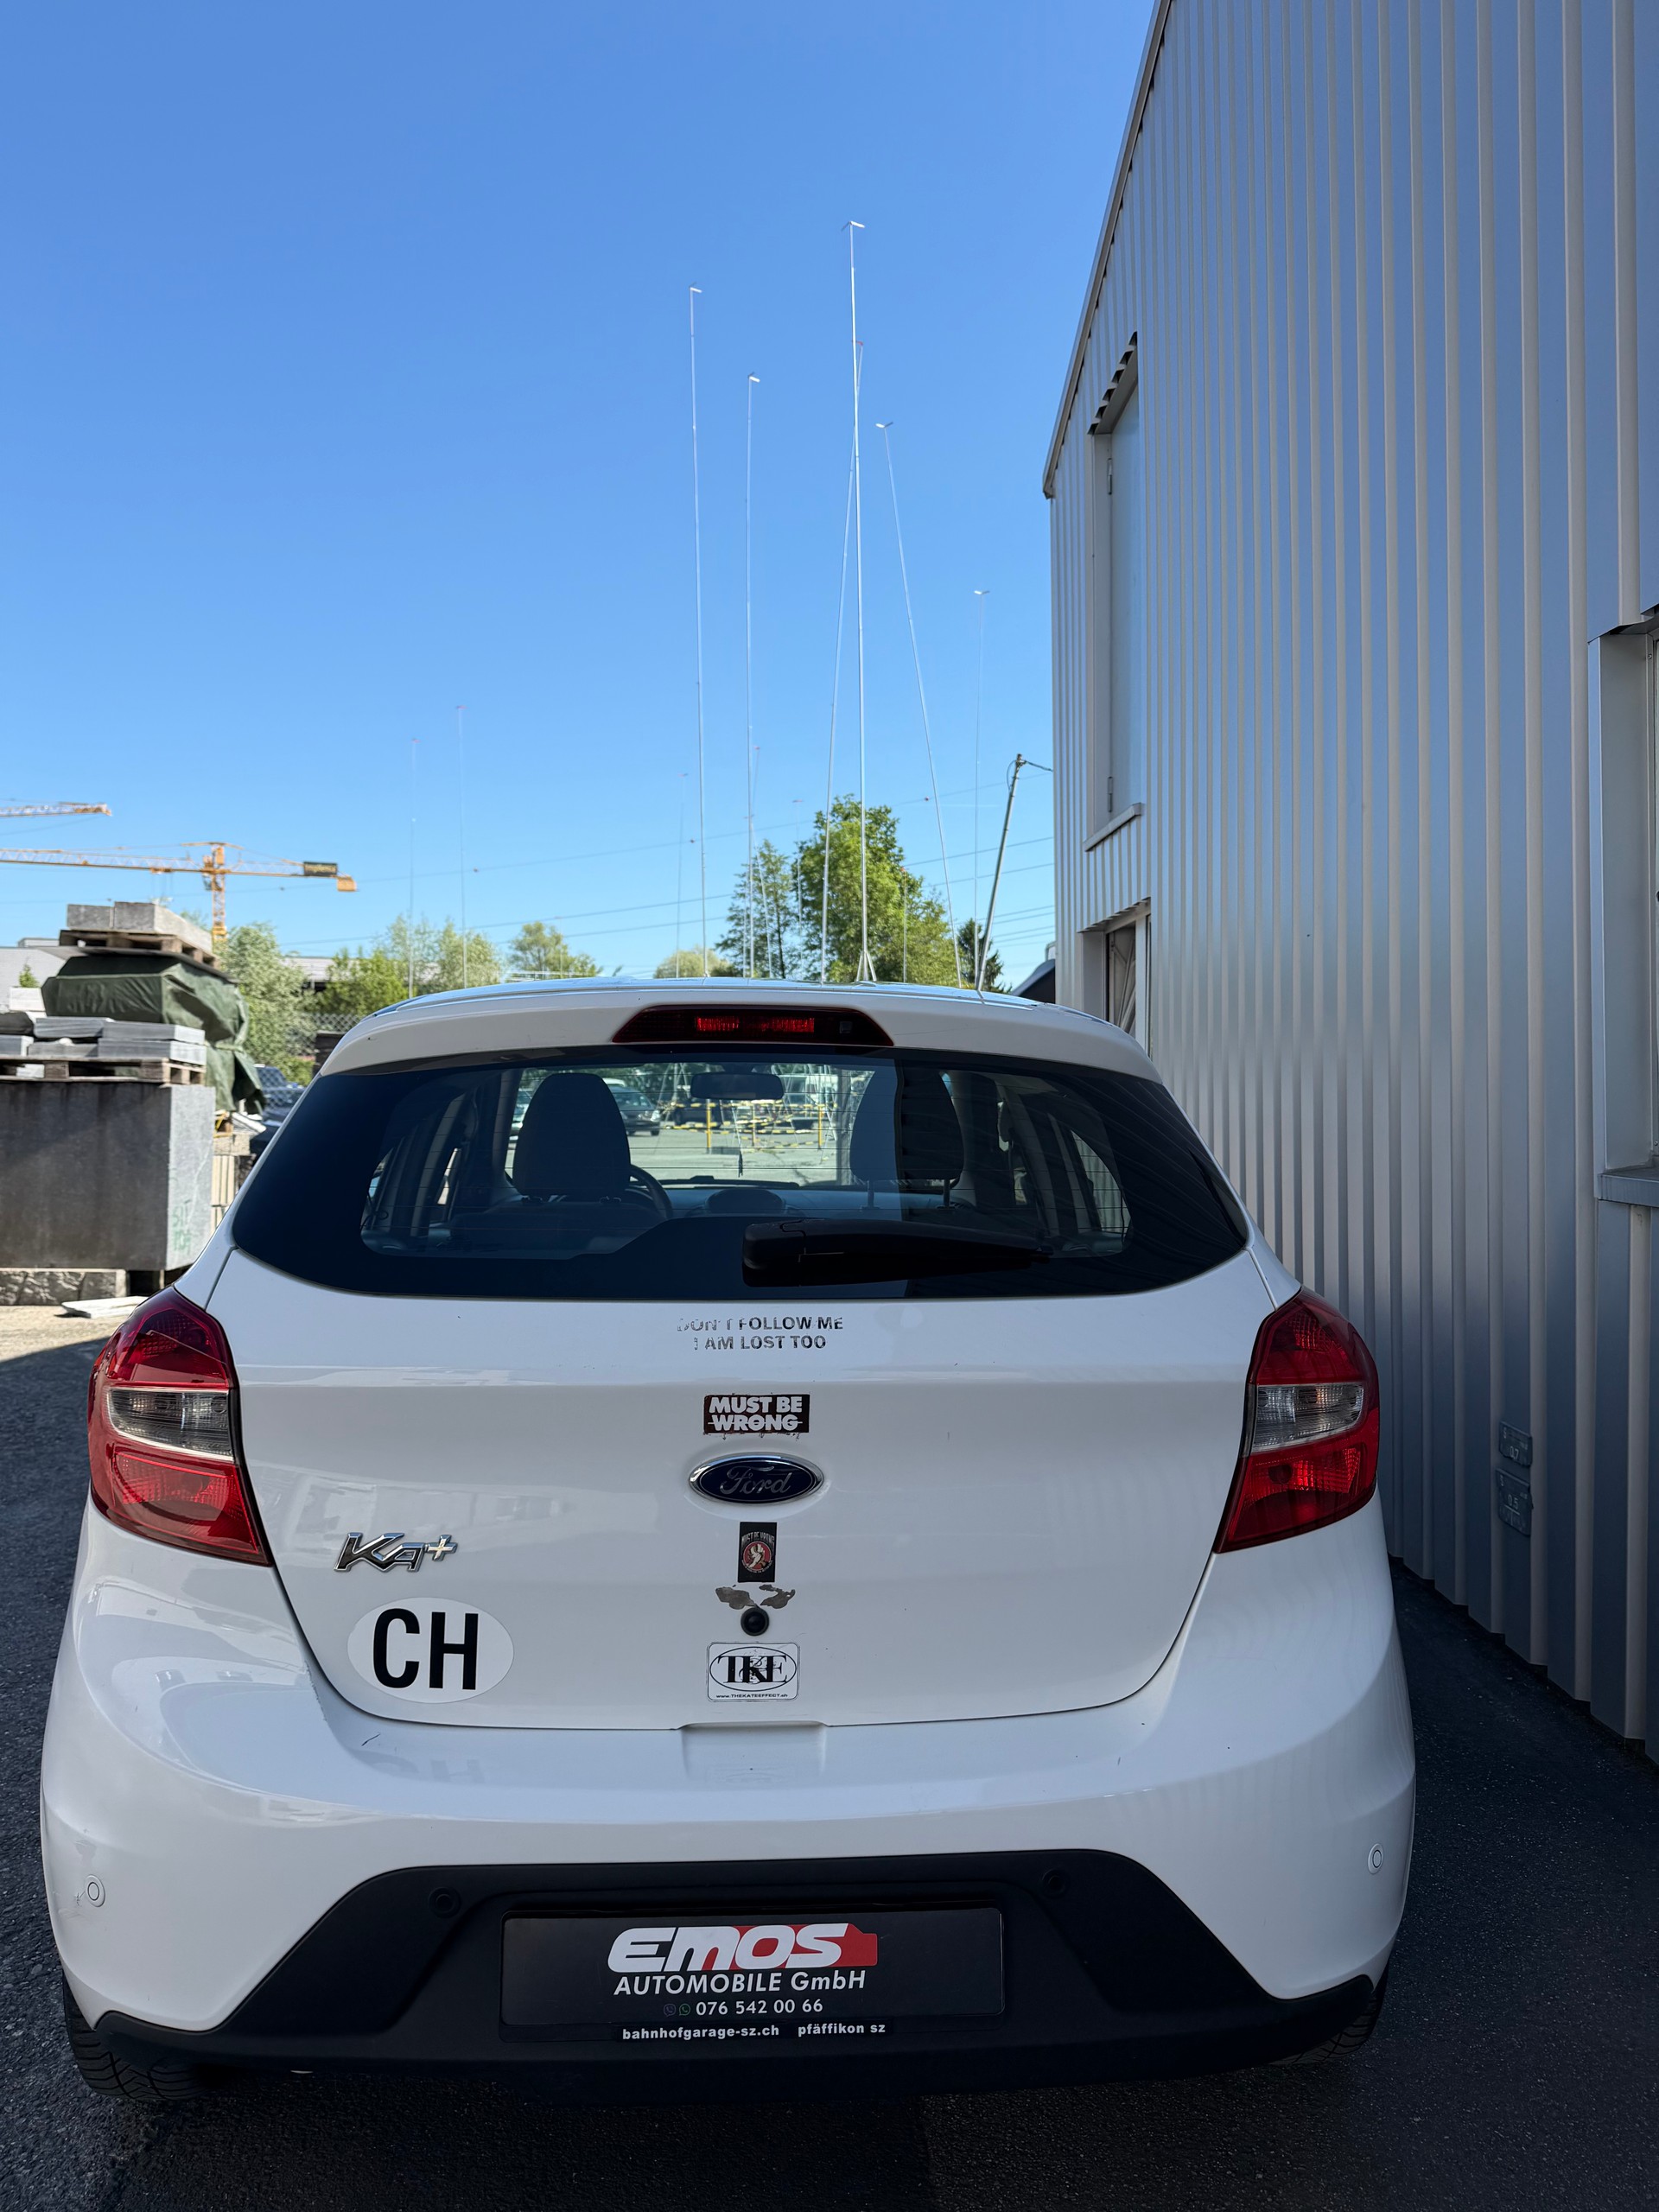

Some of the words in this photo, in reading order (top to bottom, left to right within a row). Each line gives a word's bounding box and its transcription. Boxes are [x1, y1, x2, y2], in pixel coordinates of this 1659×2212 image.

[739, 1316, 812, 1330] FOLLOW
[817, 1317, 843, 1330] ME
[705, 1336, 734, 1350] AM
[741, 1336, 785, 1349] LOST
[790, 1335, 826, 1349] TOO
[709, 1396, 772, 1414] MUST
[776, 1396, 803, 1413] BE
[708, 1414, 803, 1431] WRONG
[720, 1465, 792, 1495] Ford
[373, 1608, 479, 1690] CH
[613, 1972, 782, 1996] AUTOMOBILE
[791, 1970, 866, 1991] GmbH
[696, 2001, 728, 2016] 076
[735, 2000, 767, 2015] 542
[773, 1999, 796, 2014] 00
[802, 1999, 823, 2013] 66
[622, 2026, 779, 2041] bahnhofgarage-sz.ch
[798, 2024, 864, 2037] pfäffikon
[870, 2024, 886, 2034] sz
